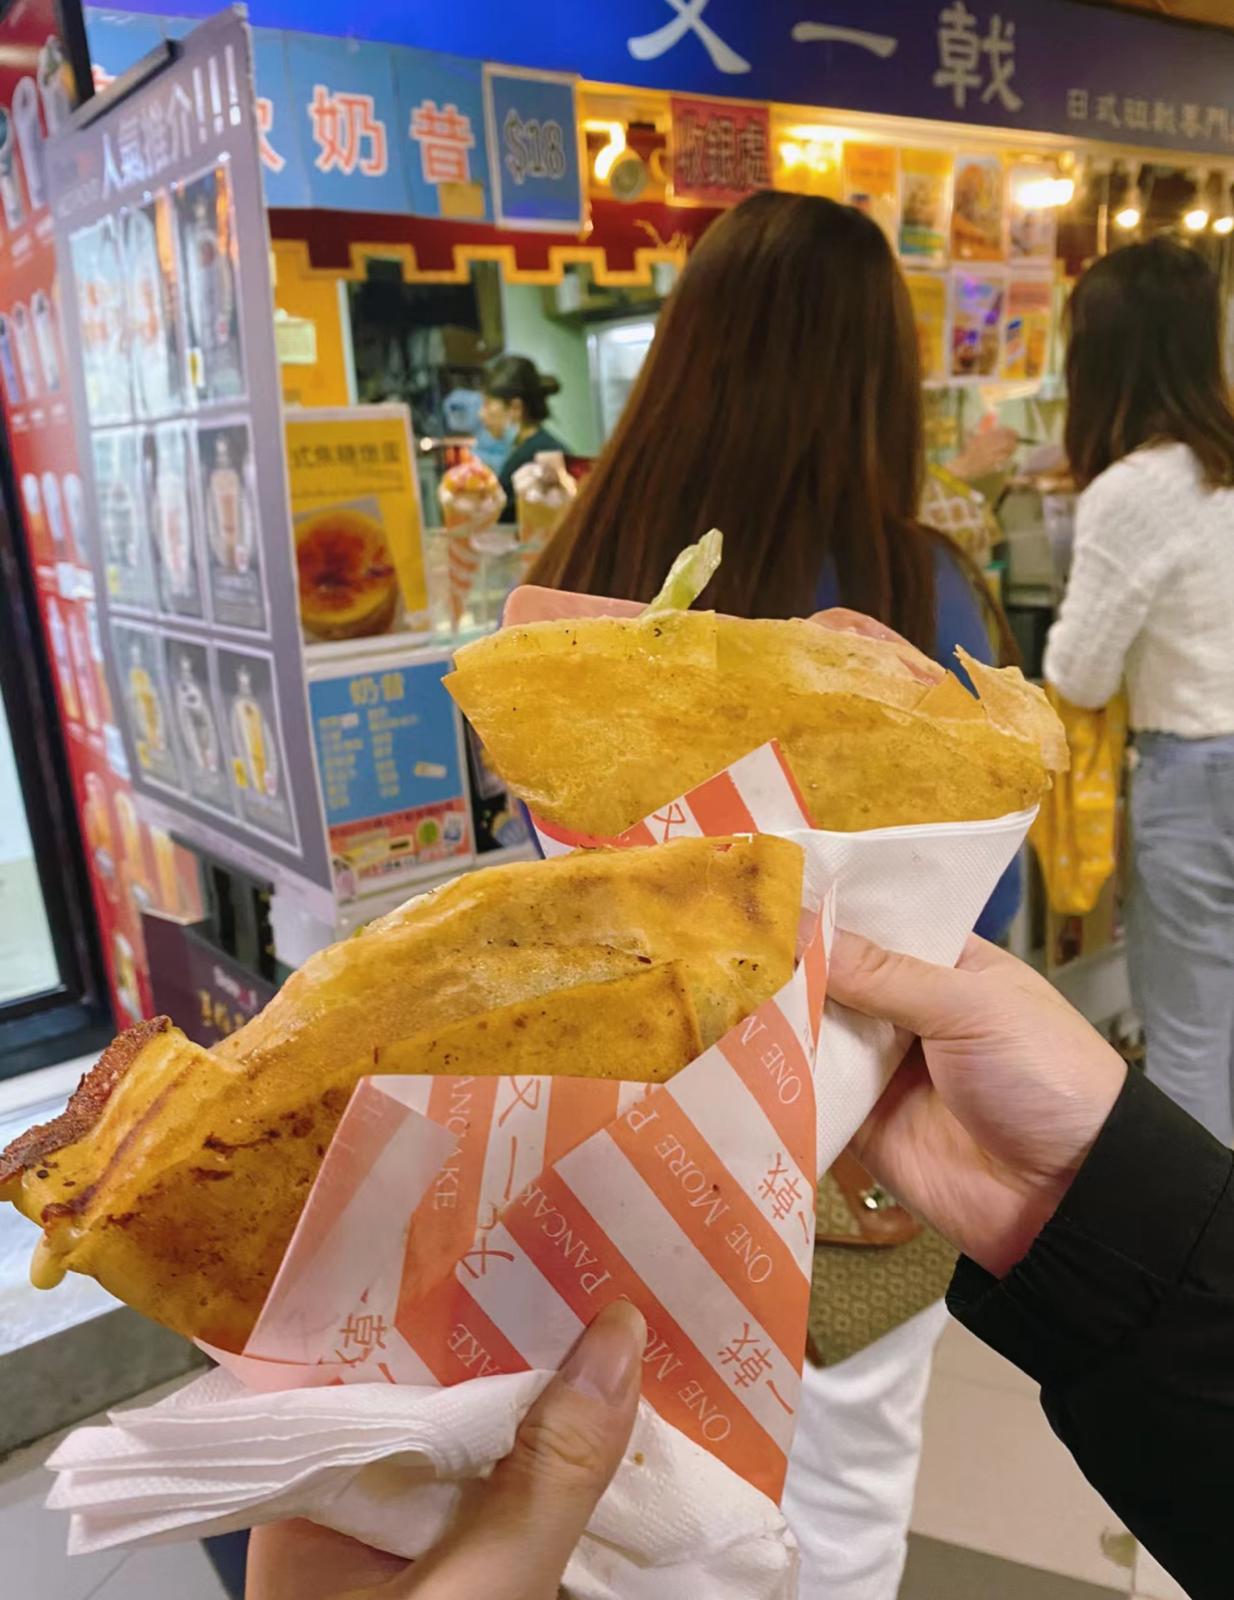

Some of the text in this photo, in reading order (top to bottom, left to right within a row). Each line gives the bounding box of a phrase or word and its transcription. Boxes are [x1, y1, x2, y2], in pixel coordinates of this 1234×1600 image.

[760, 1042, 802, 1105] ONE
[654, 1133, 731, 1228] MORE
[724, 1223, 773, 1284] ONE
[678, 1379, 732, 1442] ONE
